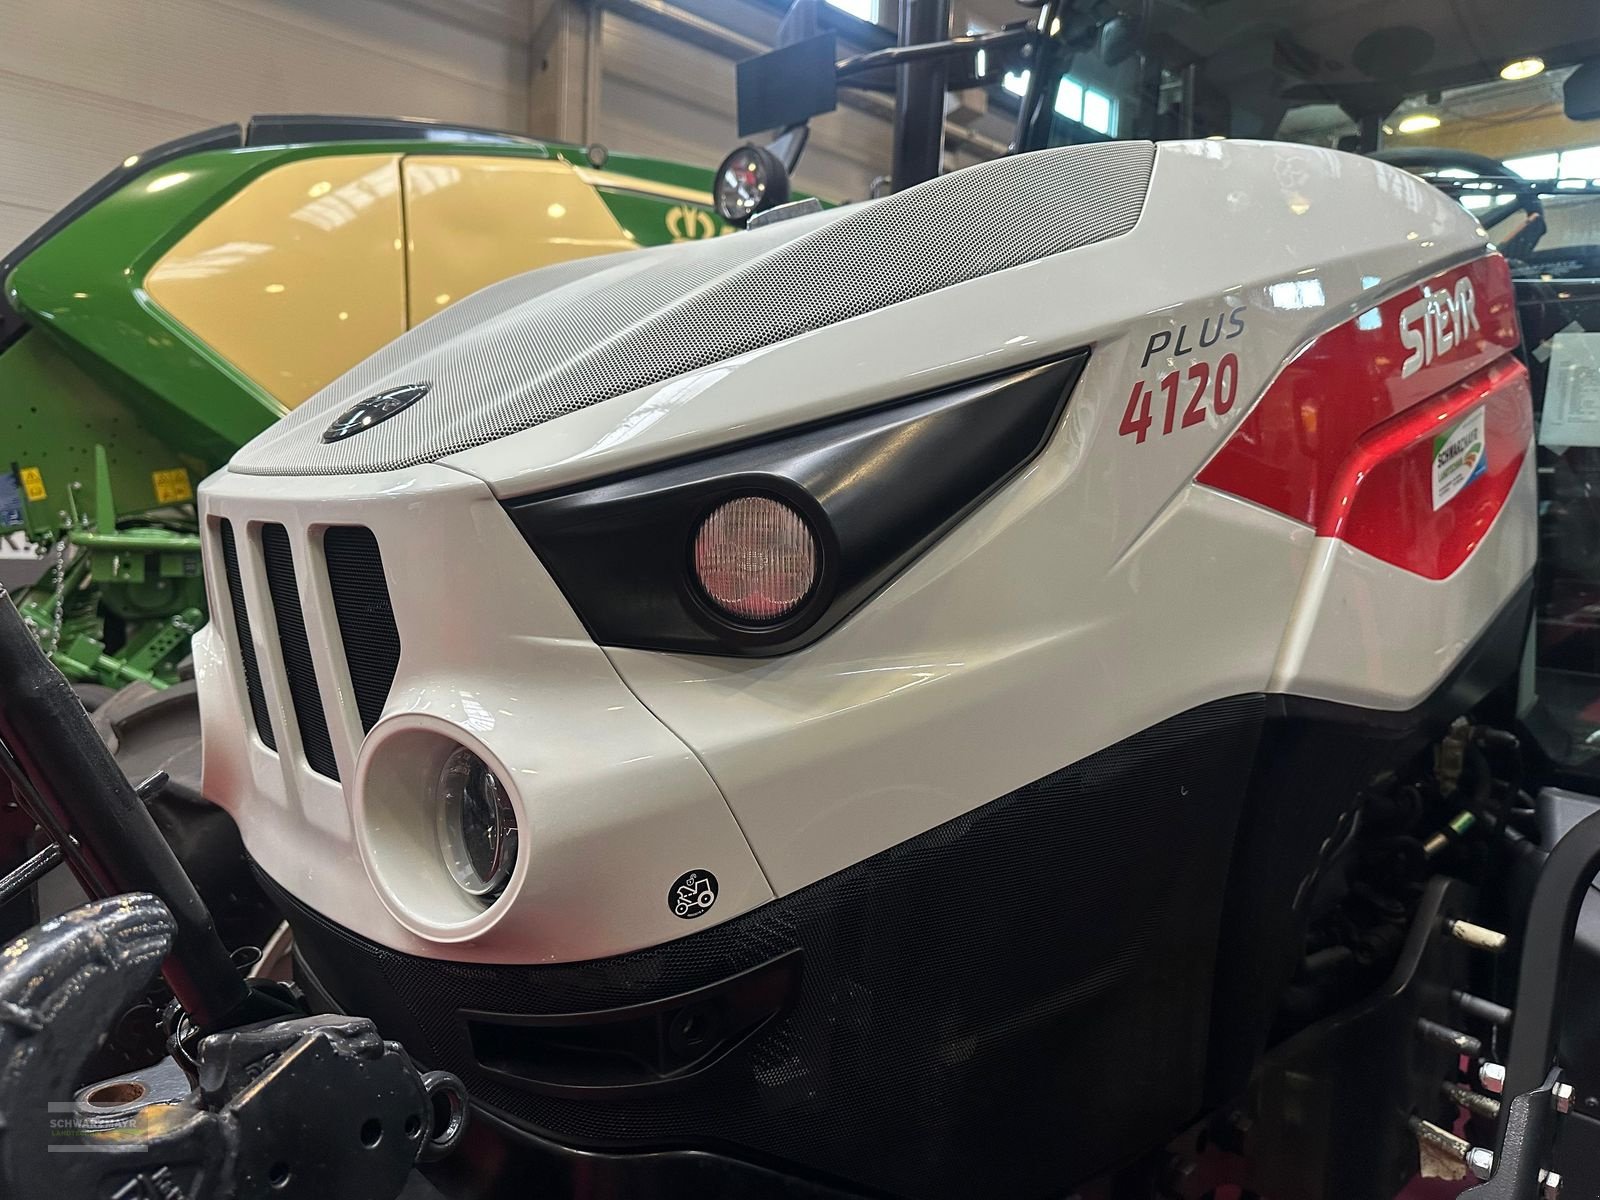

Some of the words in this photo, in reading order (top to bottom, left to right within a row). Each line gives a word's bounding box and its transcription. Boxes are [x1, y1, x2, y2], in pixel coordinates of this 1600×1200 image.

[1140, 305, 1247, 369] PLUS
[1399, 276, 1480, 379] STEYR
[1118, 352, 1239, 445] 4120
